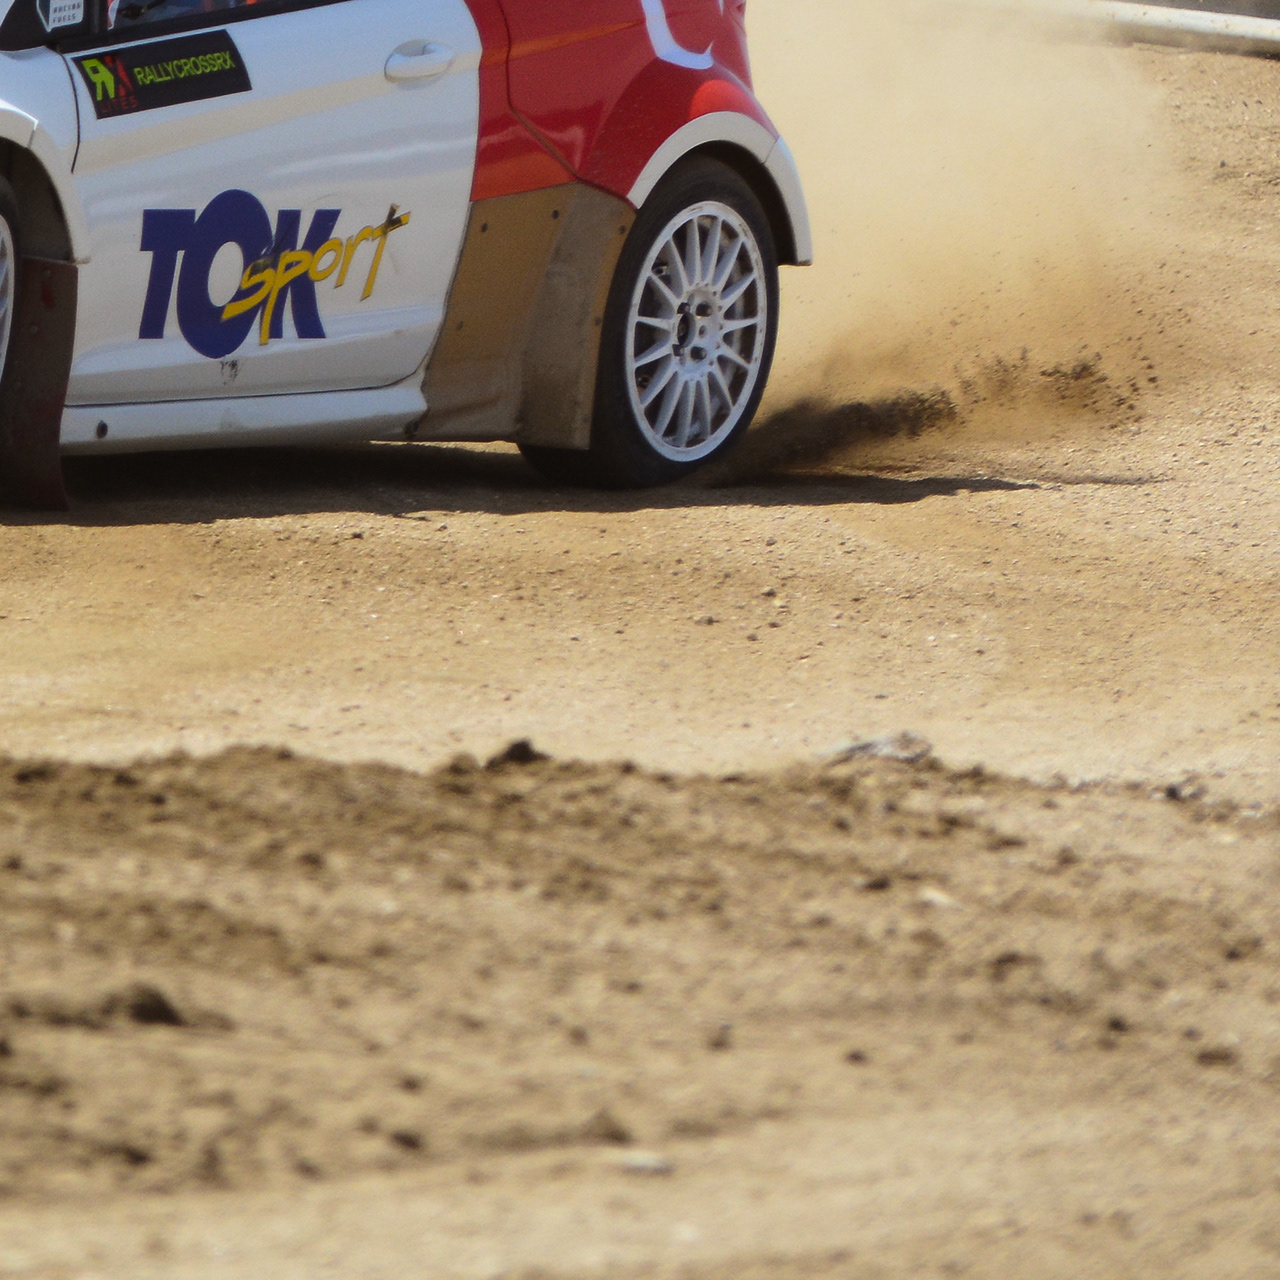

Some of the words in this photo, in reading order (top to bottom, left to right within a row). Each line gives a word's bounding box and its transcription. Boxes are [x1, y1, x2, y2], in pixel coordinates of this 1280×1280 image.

[134, 50, 236, 86] RALLYCROSSRX
[139, 188, 342, 359] TOK
[221, 203, 412, 347] sport
